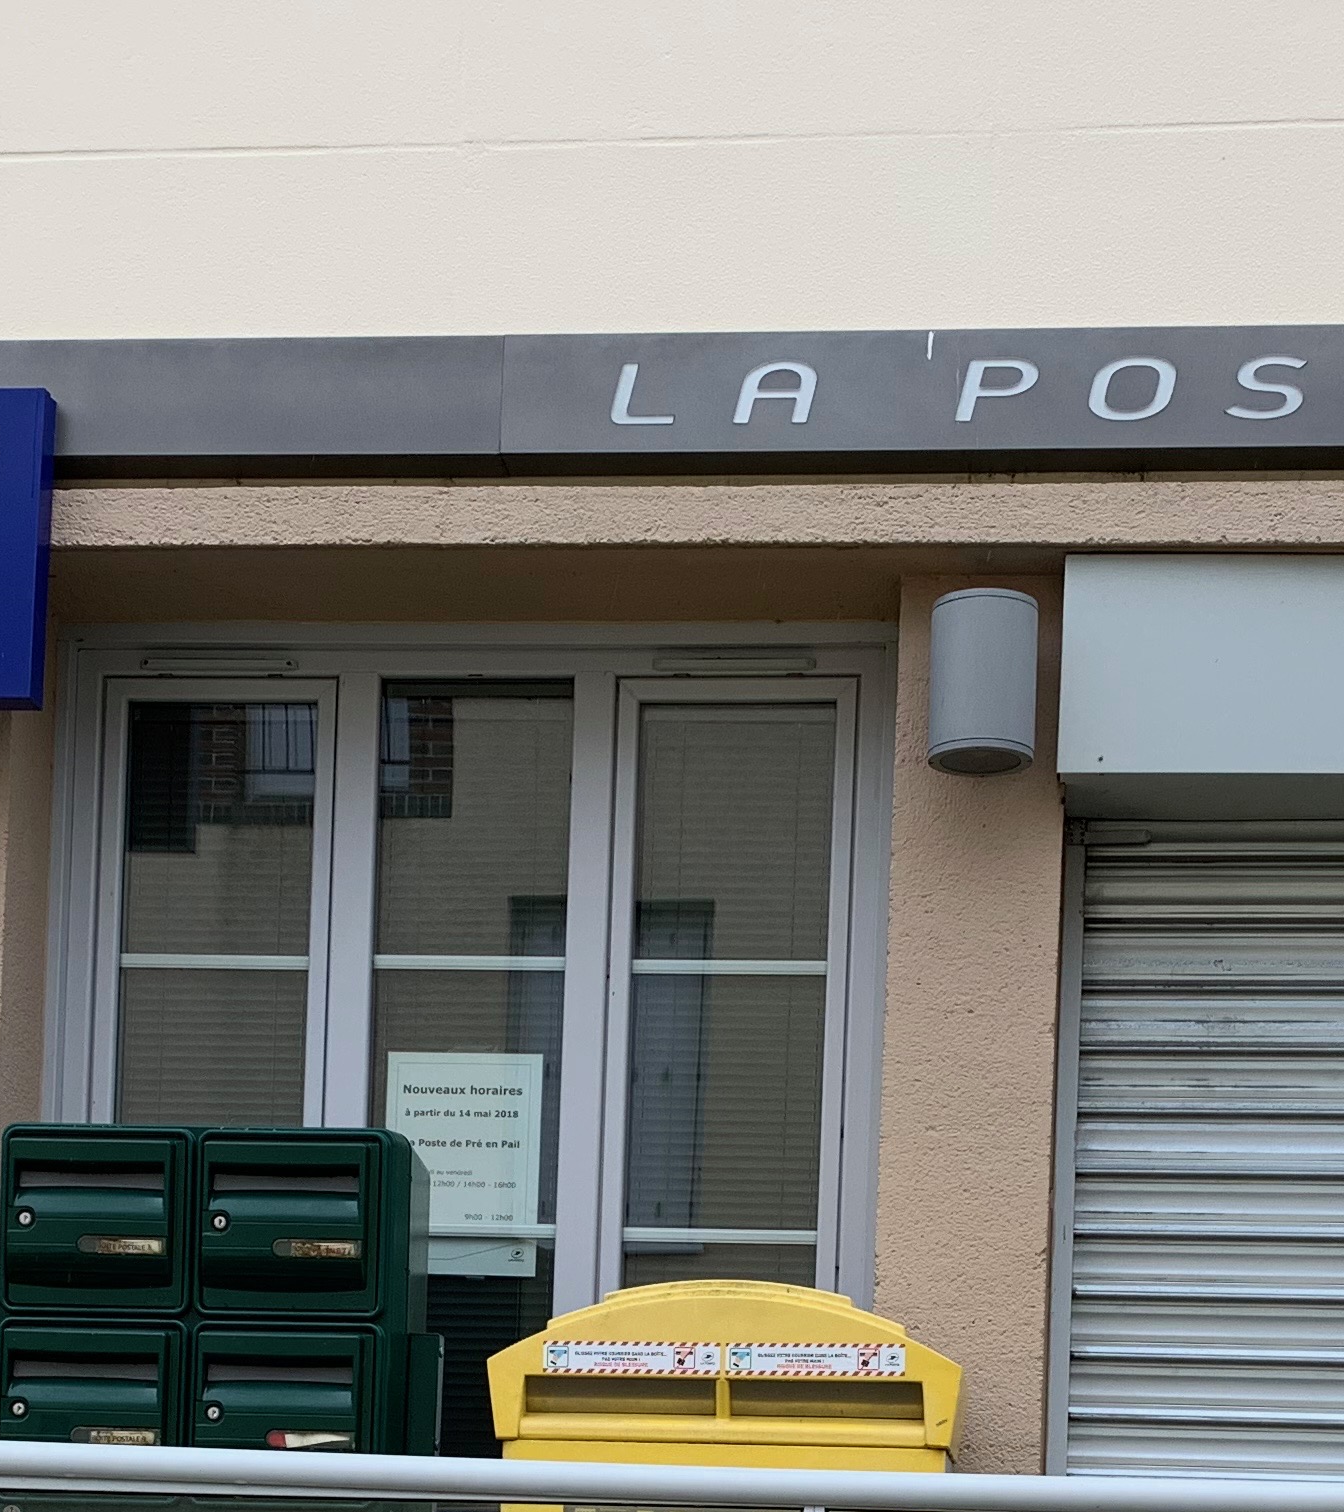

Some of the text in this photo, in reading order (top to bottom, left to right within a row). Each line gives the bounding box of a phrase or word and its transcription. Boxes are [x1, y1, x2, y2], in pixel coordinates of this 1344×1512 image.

[609, 360, 819, 427] LA
[403, 1084, 523, 1096] Nouveaux horaires
[404, 1108, 519, 1118] à partir du 14 mai 2018
[418, 1139, 446, 1148] Poste
[450, 1139, 462, 1148] de
[466, 1139, 483, 1148] Pré
[502, 1140, 520, 1148] Pail
